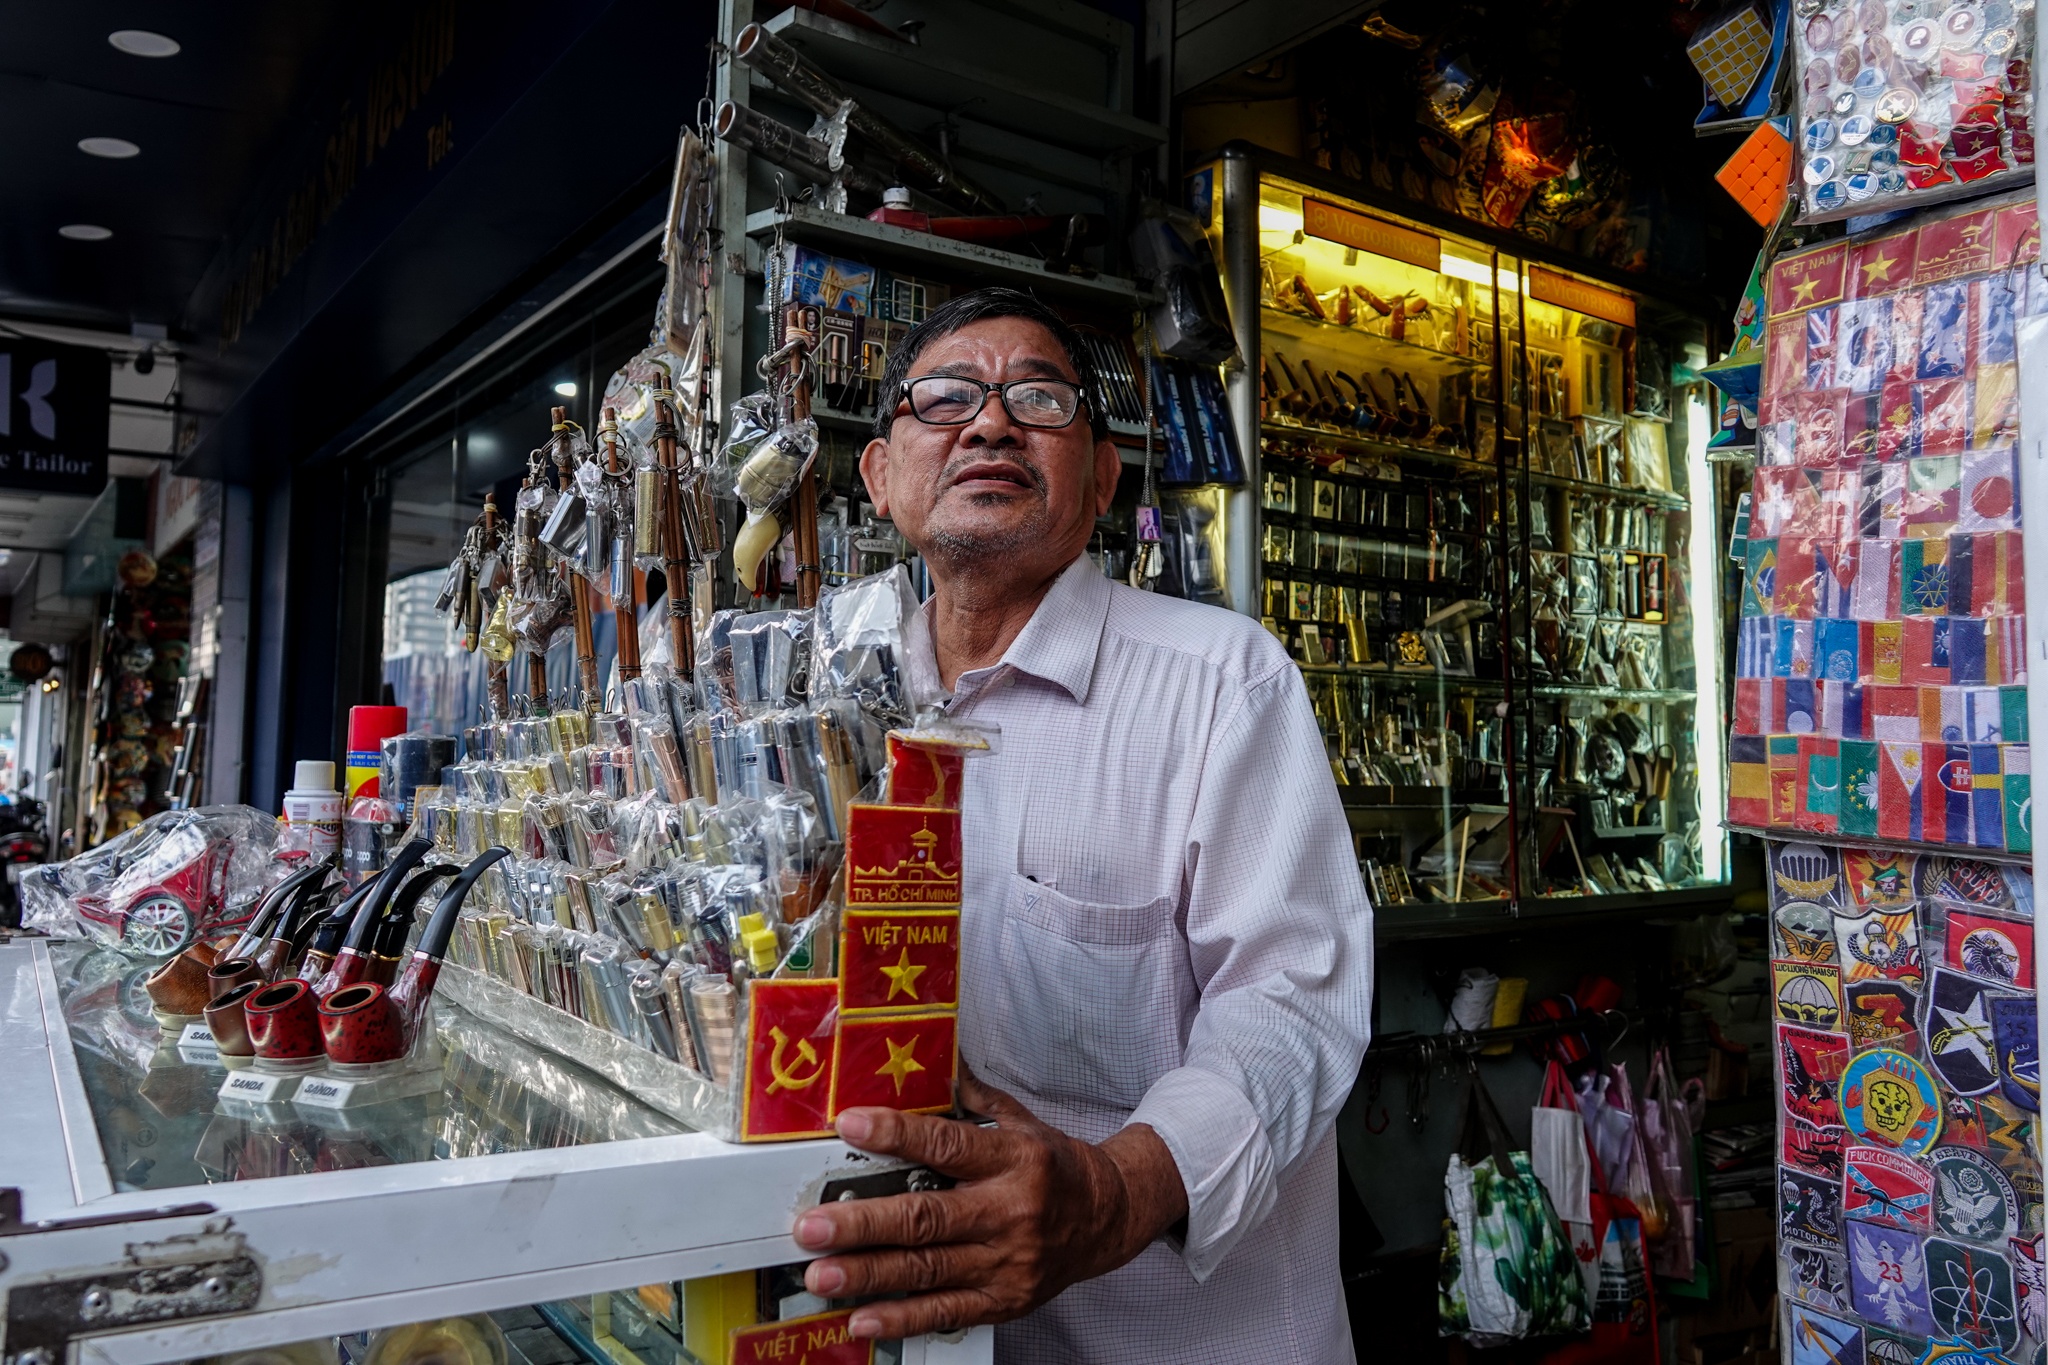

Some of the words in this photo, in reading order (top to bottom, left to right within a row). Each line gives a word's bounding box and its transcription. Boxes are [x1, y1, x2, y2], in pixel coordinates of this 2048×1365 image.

[1332, 212, 1433, 262] VICTORINOX
[1781, 260, 1806, 278] VIỆT
[1808, 252, 1838, 270] NAM
[1552, 279, 1629, 319] VICTORINOX
[17, 450, 93, 475] Tailor
[853, 887, 874, 901] TP.
[878, 883, 900, 901] HỒ
[900, 884, 925, 901] CHÍ
[926, 888, 958, 901] MINH
[1950, 859, 1997, 903] SQUAD
[862, 920, 902, 951] VIỆT
[907, 925, 948, 944] NAM
[190, 1031, 214, 1041] SAN
[231, 1078, 264, 1091] SANDA
[304, 1083, 338, 1097] SANDA
[1849, 1150, 1876, 1162] FUCK
[1935, 1147, 1977, 1163] SERVE
[1979, 1159, 2017, 1222] PROUDLY
[1783, 1225, 1819, 1244] MOTOR
[1878, 1260, 1904, 1283] 23
[754, 1332, 801, 1362] VIỆT
[807, 1325, 856, 1350] NAM
